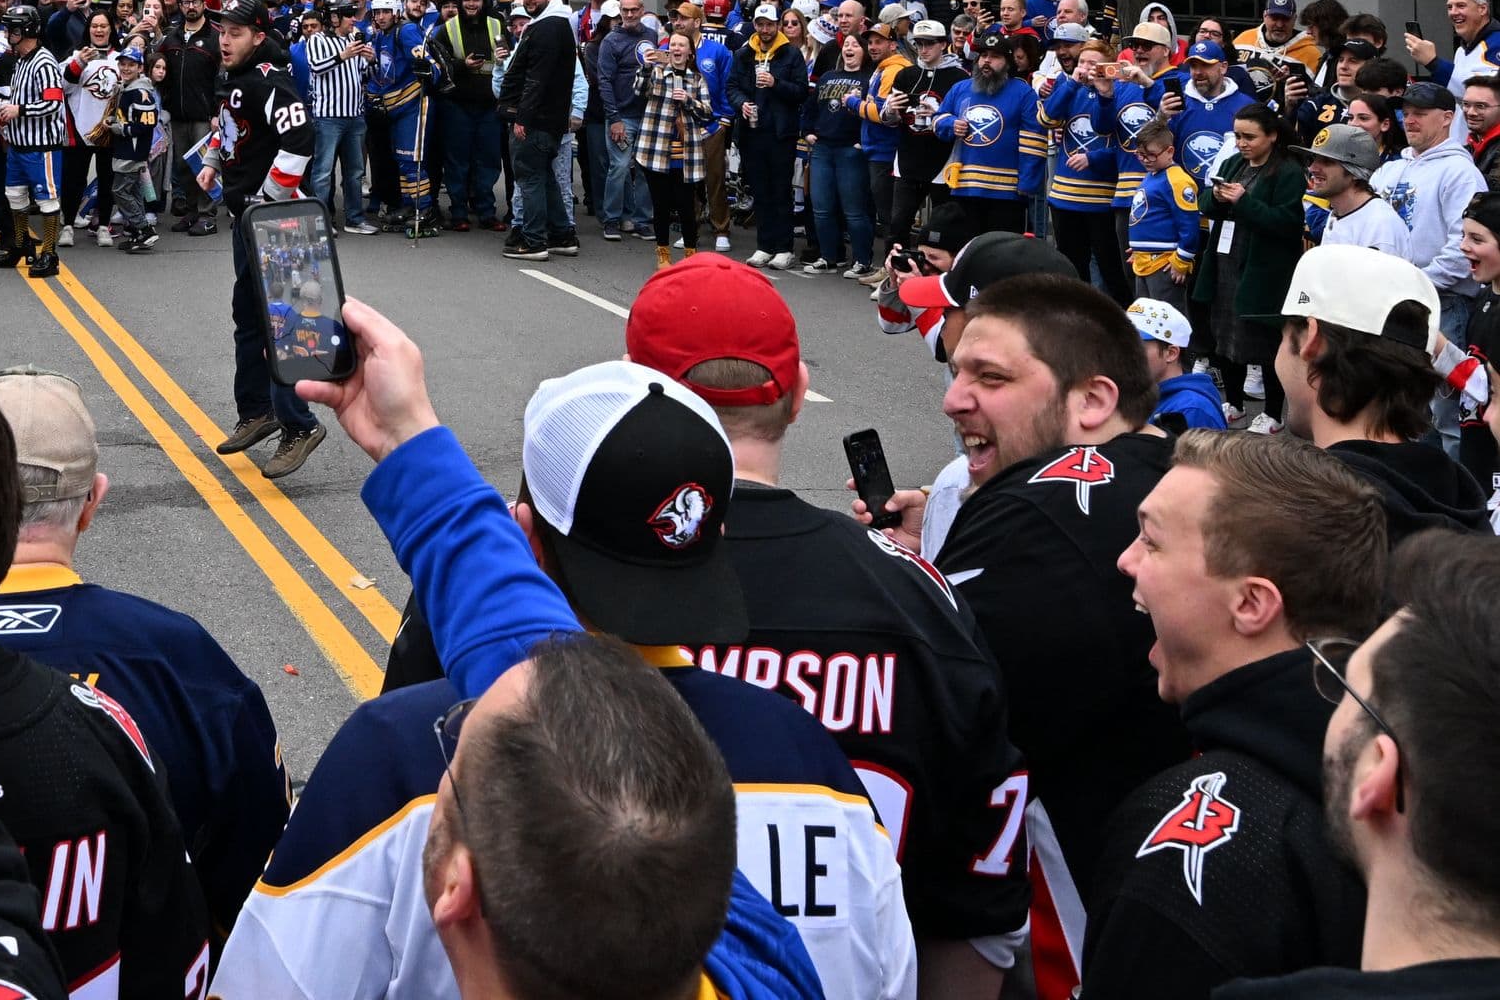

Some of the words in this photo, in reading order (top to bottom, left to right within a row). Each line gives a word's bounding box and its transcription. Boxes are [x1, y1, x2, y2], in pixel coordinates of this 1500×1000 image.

[230, 88, 242, 108] C
[826, 78, 860, 86] BUFFALO
[274, 102, 306, 134] 26
[971, 770, 1030, 877] 7
[767, 824, 837, 918] LE
